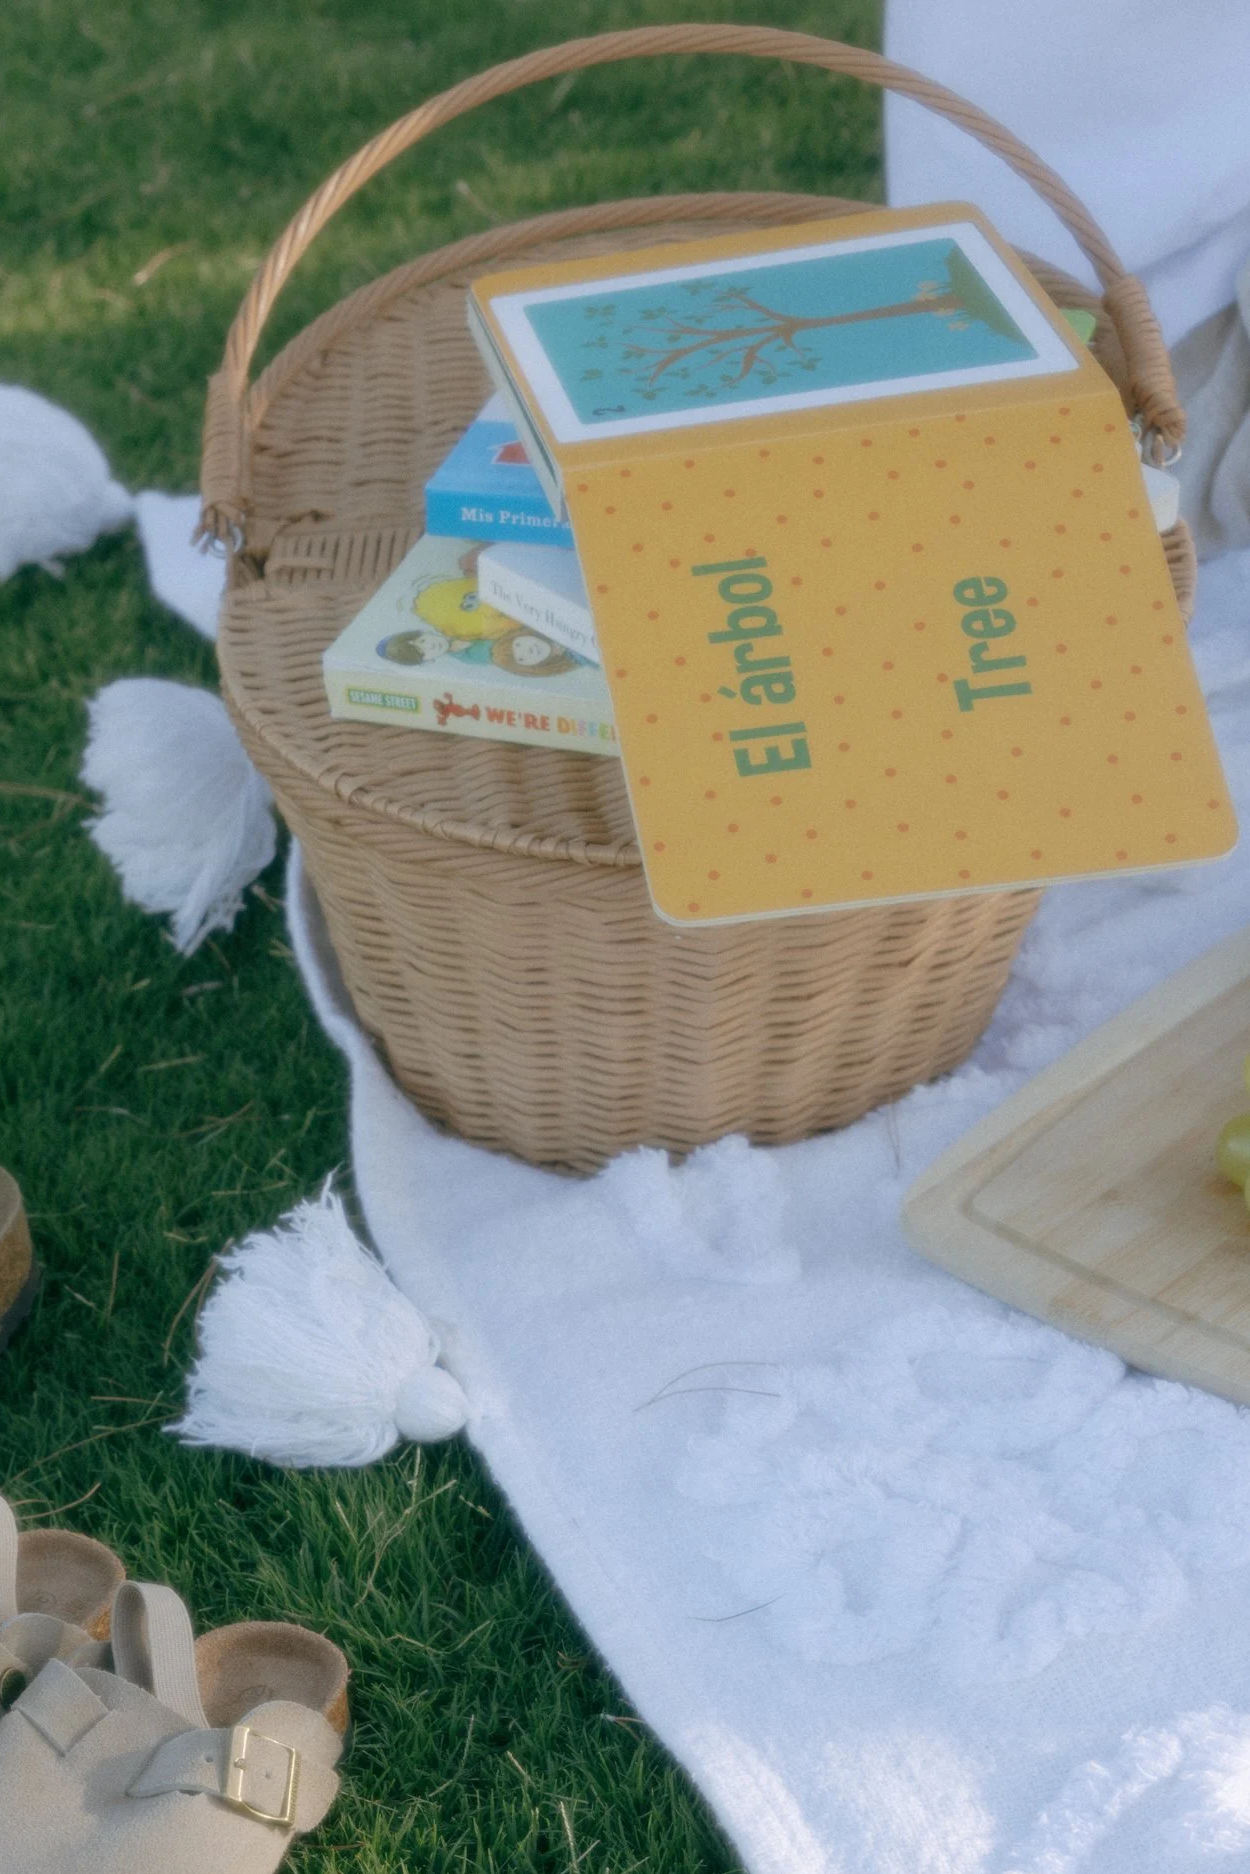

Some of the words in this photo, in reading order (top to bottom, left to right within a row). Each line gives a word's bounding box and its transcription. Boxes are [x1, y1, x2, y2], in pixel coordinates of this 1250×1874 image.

[460, 507, 493, 523] Mis
[514, 592, 541, 622] Very
[544, 608, 587, 648] Hungry
[691, 556, 797, 705] árbol
[953, 576, 1034, 712] Tree
[485, 705, 550, 732] WE'RE
[728, 721, 812, 777] El
